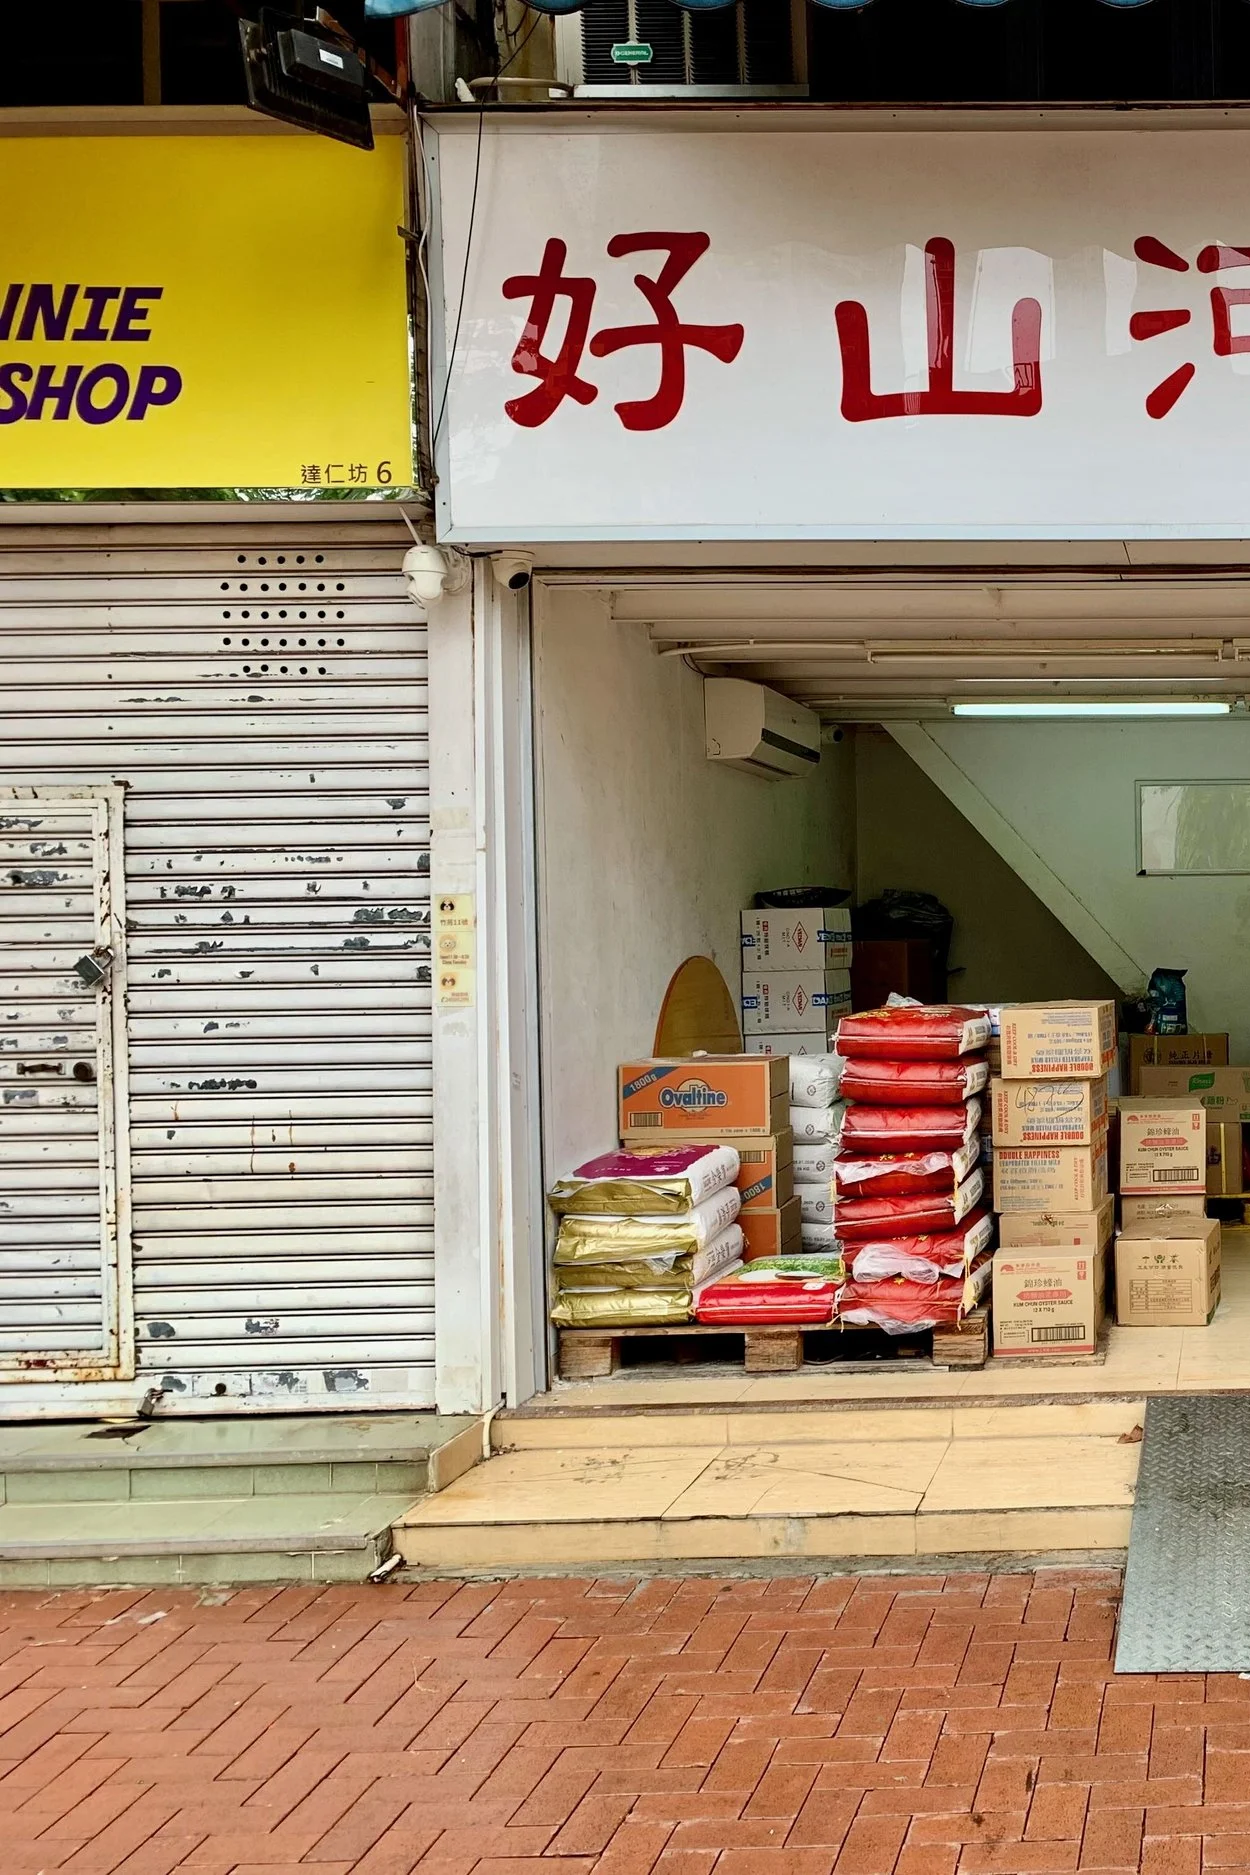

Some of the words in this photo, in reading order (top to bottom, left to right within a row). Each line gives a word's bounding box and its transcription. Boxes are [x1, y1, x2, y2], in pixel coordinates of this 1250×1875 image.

[300, 463, 368, 485] 達仁坊
[375, 460, 393, 485] 6
[1031, 1064, 1069, 1073] HAPPINESS
[1070, 1063, 1094, 1072] DOUBLE
[660, 1085, 727, 1108] Ovaltine
[1023, 1132, 1059, 1140] HAPPINESS
[1061, 1131, 1084, 1139] DOUBLE
[999, 1151, 1022, 1160] DOUBLE
[1024, 1150, 1060, 1159] HAPPINESS
